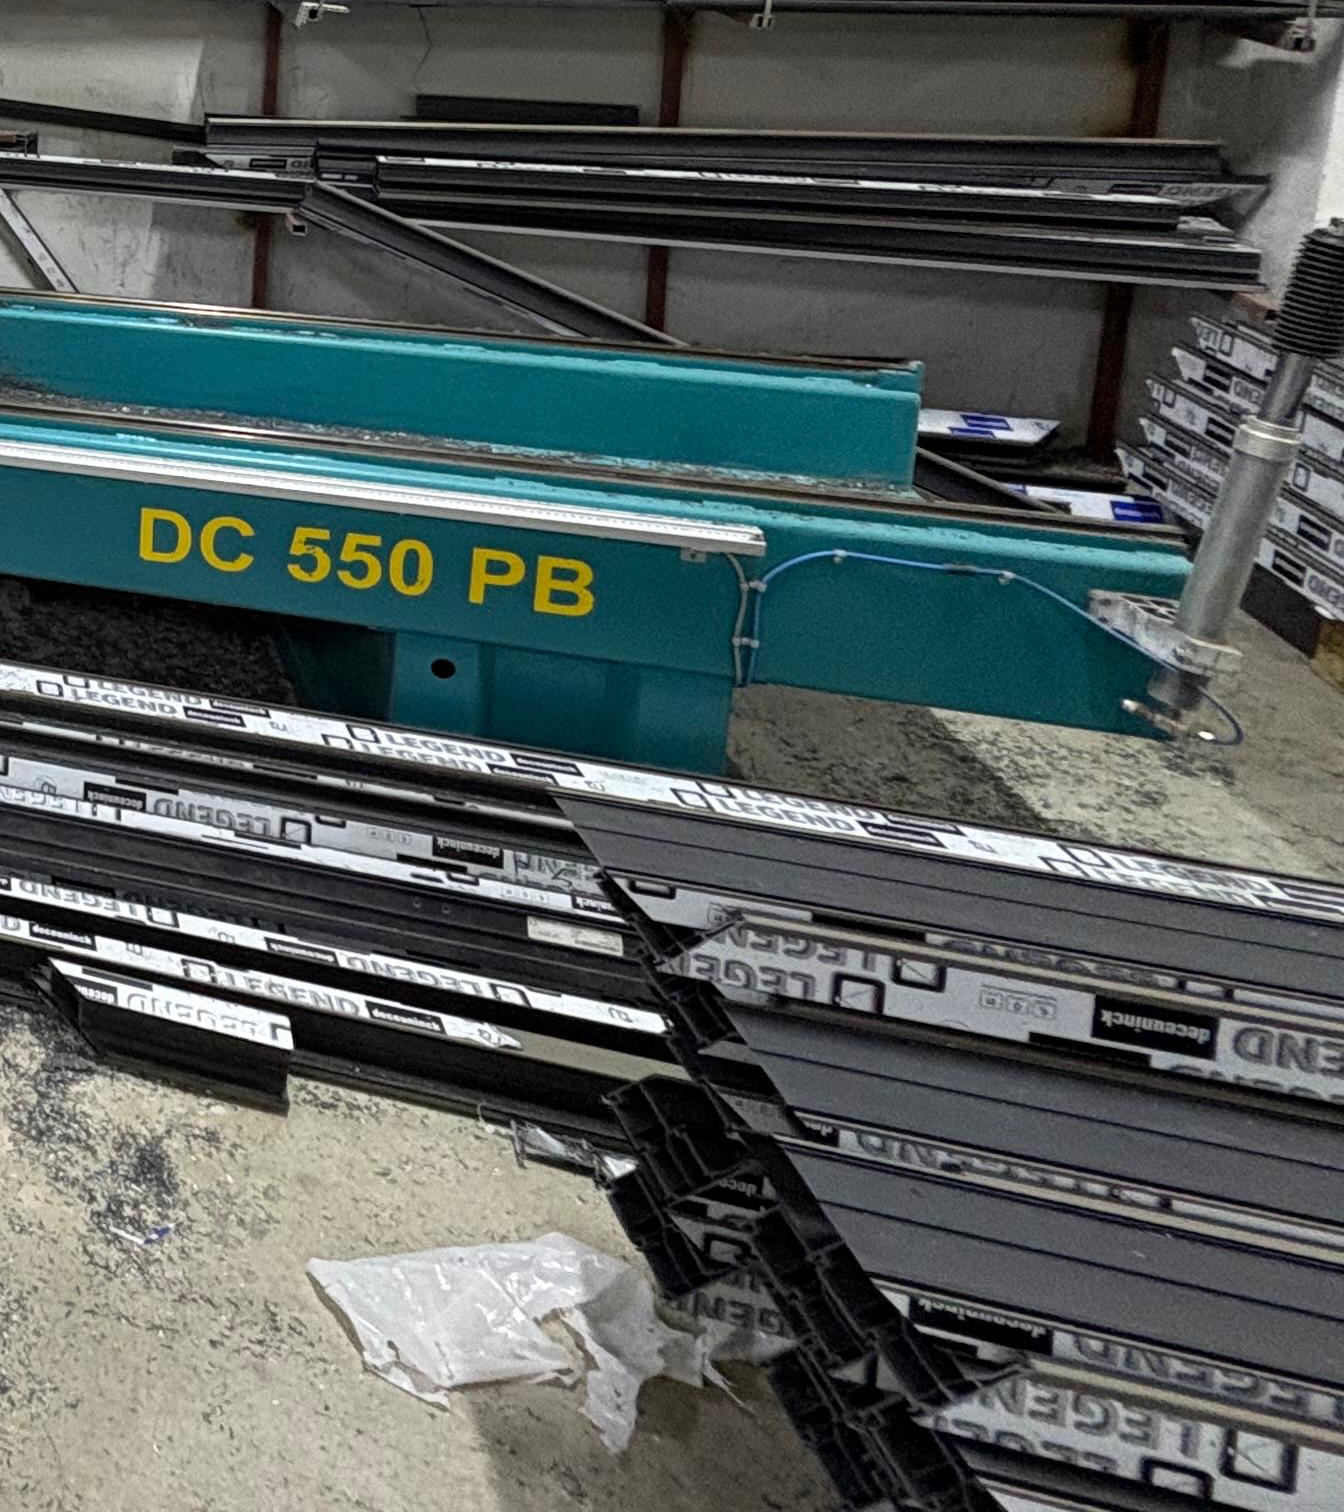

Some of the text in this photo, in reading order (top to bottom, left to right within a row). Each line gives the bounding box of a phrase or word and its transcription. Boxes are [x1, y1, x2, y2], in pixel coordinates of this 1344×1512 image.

[139, 507, 595, 617] DC 550 PB
[72, 689, 177, 715] LEGEND
[386, 733, 506, 763] LEGEND
[153, 798, 272, 837] LEGEND
[719, 799, 855, 831] LEGEND
[19, 879, 138, 917] LEGEND
[346, 955, 481, 996] LEGEND
[1100, 1010, 1212, 1046] deceuninck
